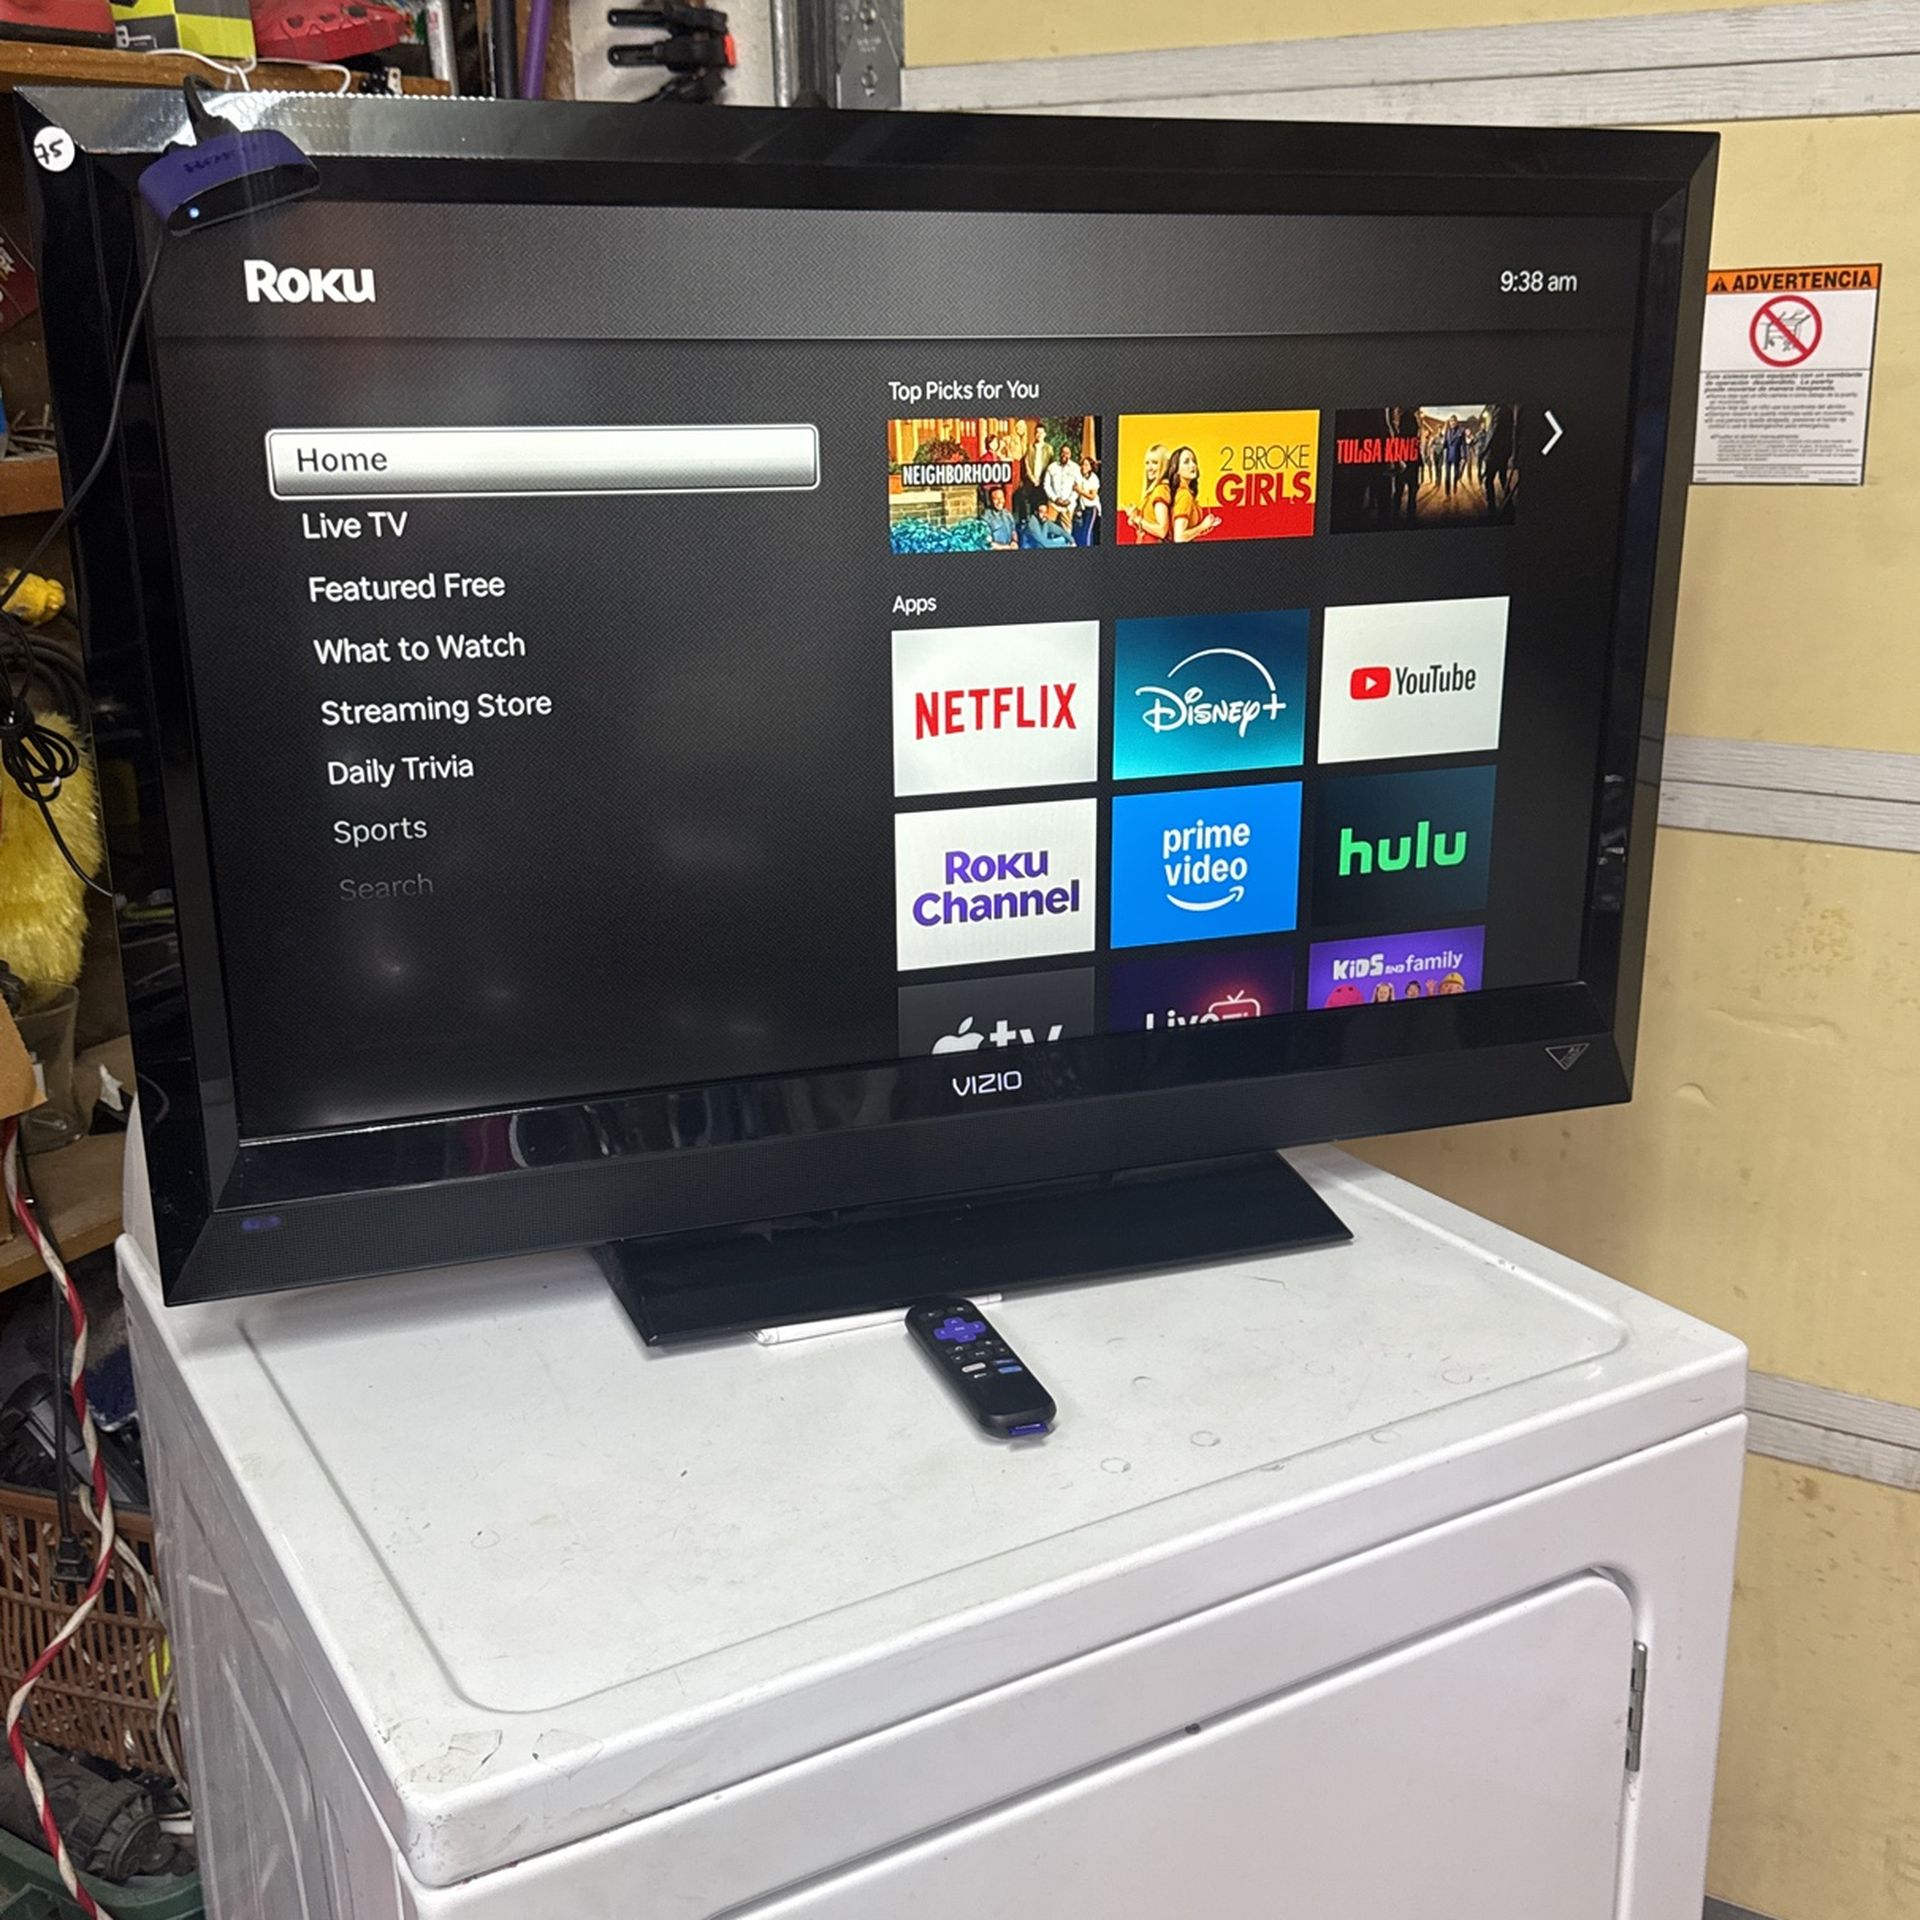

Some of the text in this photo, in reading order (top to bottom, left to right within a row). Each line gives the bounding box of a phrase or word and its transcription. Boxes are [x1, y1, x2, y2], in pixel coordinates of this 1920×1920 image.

[243, 259, 376, 303] Roku
[1500, 270, 1578, 292] 9:38 am
[1732, 270, 1872, 291] ADVERTENCIA
[889, 380, 1040, 403] Top Picks for You
[297, 448, 387, 472] Home
[1220, 444, 1311, 471] 2 BROKE
[1337, 436, 1419, 464] TULSA KING
[903, 463, 1012, 485] NEIGHBORHOOD
[1216, 471, 1312, 506] GIRLS
[302, 511, 408, 539] Live TV
[308, 572, 506, 602] Featured Free
[892, 595, 937, 616] Apps
[313, 631, 526, 665] What to Watch
[1395, 662, 1476, 696] YouTube
[321, 693, 553, 726] Streaming Store
[915, 683, 1077, 740] NETFLIX
[327, 754, 475, 788] Daily Trivia
[333, 817, 428, 848] Sports
[1162, 819, 1251, 858] prime
[1338, 820, 1467, 877] hulu
[1164, 856, 1248, 887] video
[339, 873, 434, 901] Search
[912, 879, 1081, 927] Channel
[1405, 950, 1463, 973] family
[951, 1070, 1023, 1097] VIZIO
